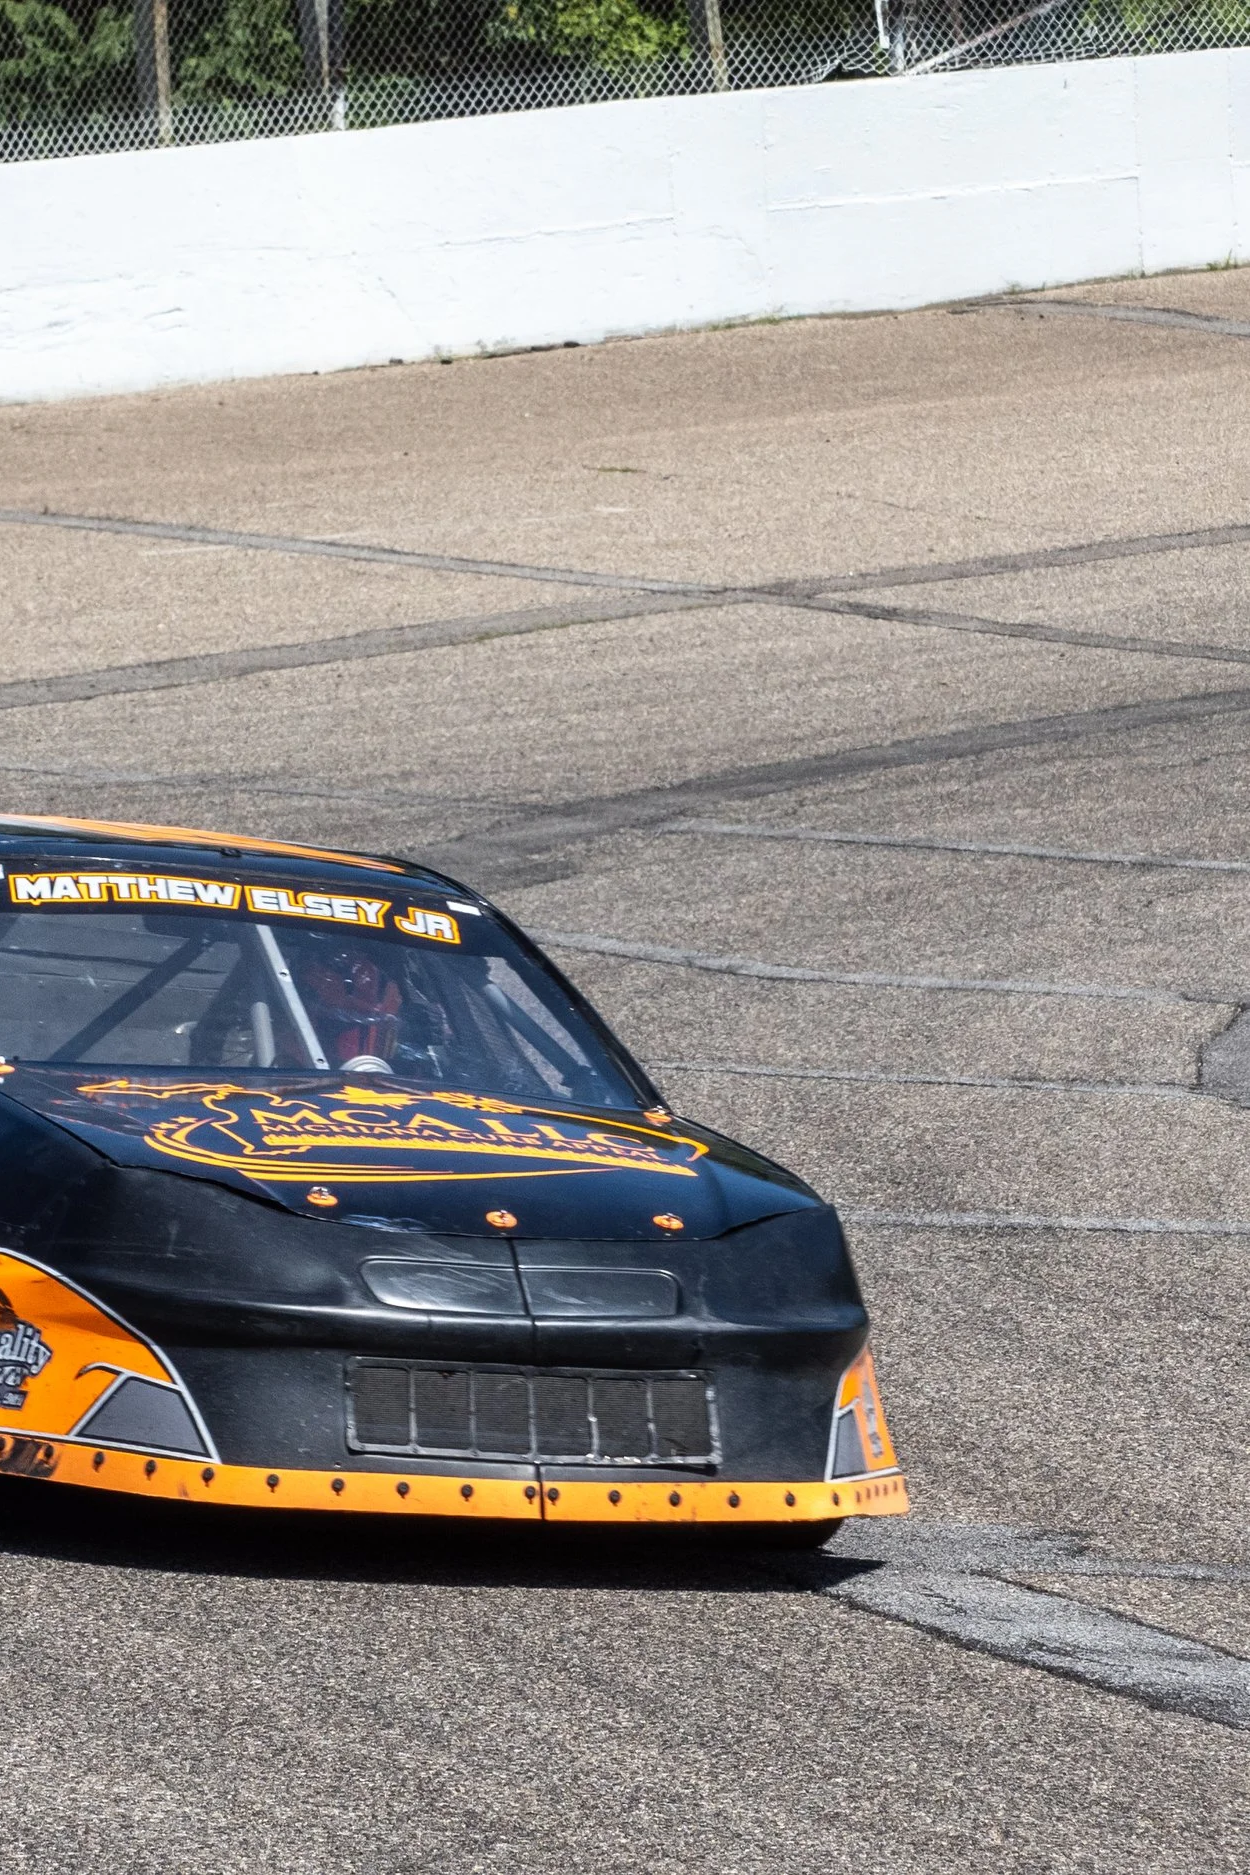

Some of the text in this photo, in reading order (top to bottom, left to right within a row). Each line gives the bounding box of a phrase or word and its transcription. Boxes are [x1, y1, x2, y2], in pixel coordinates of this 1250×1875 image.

[11, 874, 458, 942] MATTHEW ELSEY JR
[249, 1108, 656, 1152] MCA LLC
[261, 1124, 669, 1162] MICHIANA CURB APPEAL
